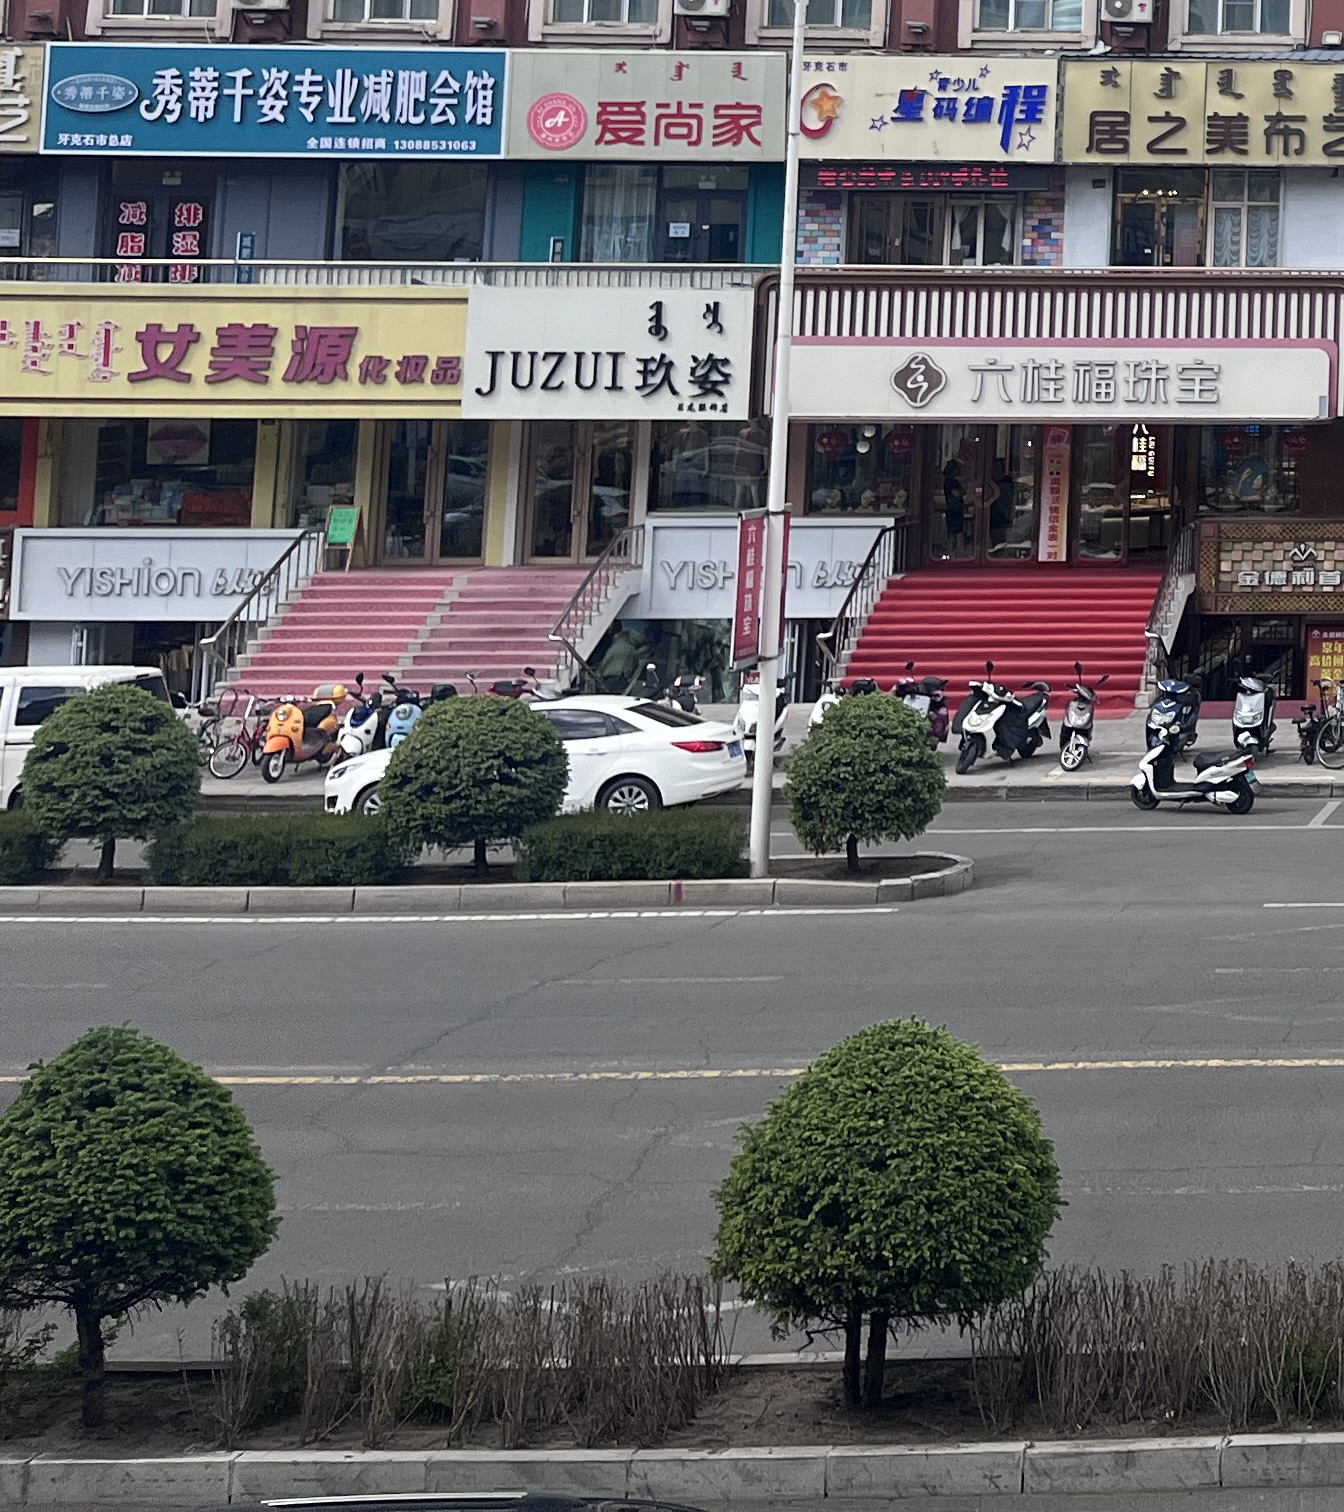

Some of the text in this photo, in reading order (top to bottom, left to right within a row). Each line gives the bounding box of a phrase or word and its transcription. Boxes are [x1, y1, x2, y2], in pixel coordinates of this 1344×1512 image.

[140, 67, 495, 126] 秀蒂千姿专业减肥会馆
[938, 77, 979, 92] 青少儿
[595, 101, 763, 148] 爱尚家
[358, 355, 462, 385] 化妆品
[475, 351, 732, 398] JUZUI 玖姿
[968, 357, 1222, 405] 六桂福珠宝
